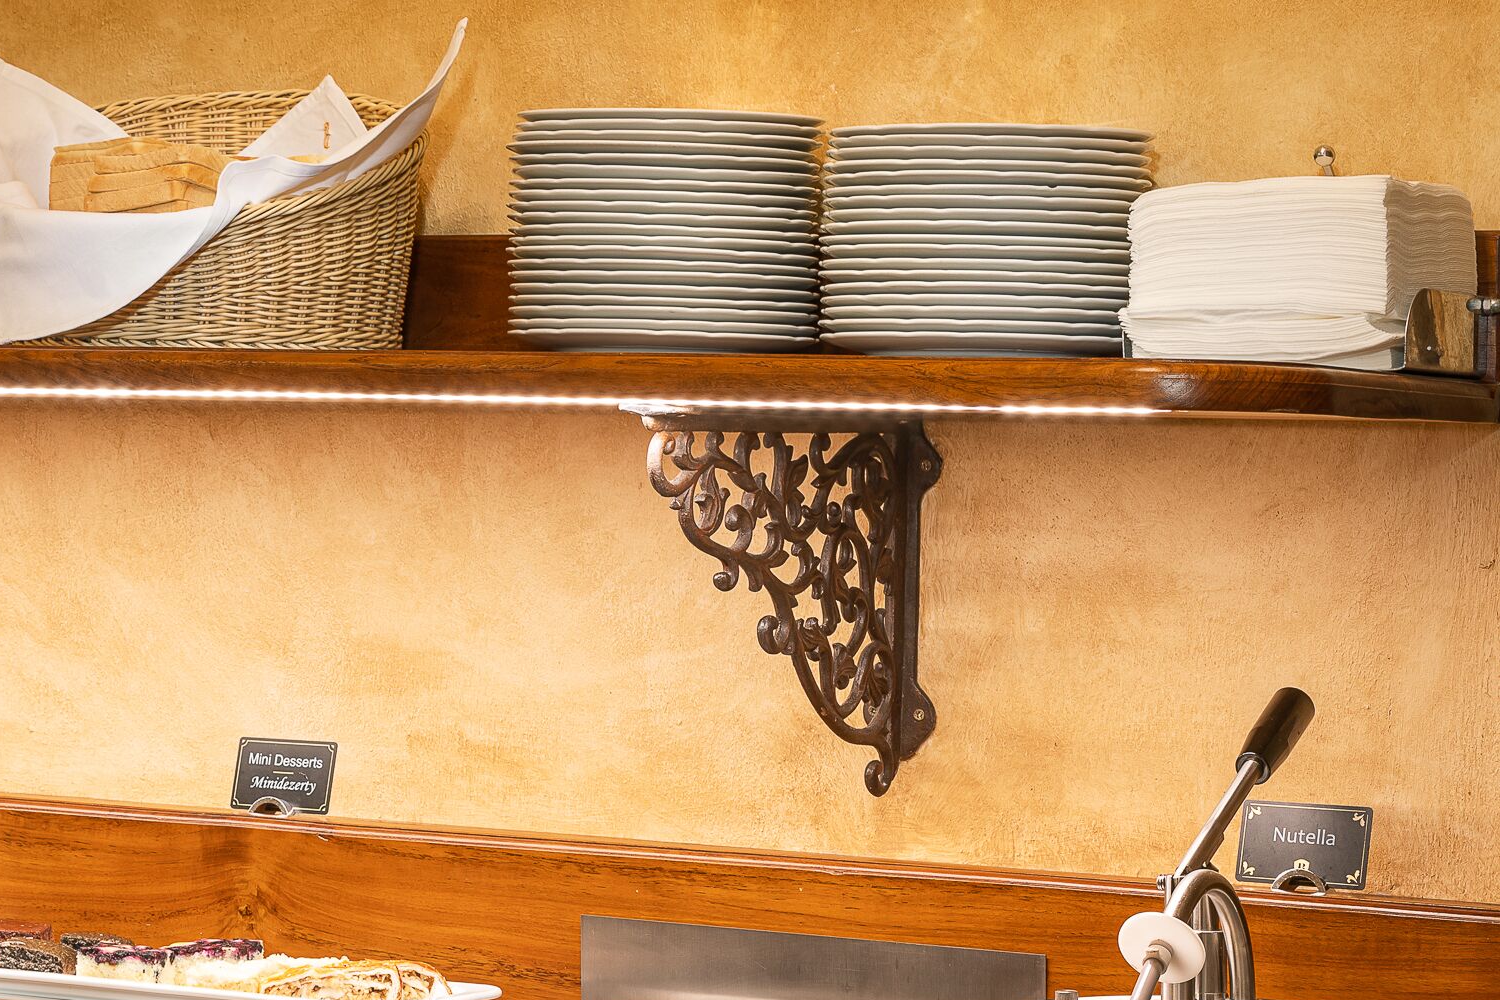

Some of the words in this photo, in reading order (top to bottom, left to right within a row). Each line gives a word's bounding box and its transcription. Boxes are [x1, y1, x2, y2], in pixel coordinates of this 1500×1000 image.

[248, 752, 272, 766] Mini
[274, 754, 323, 769] Desserts
[250, 776, 317, 796] Minidezerty
[1273, 827, 1336, 846] Nutella
